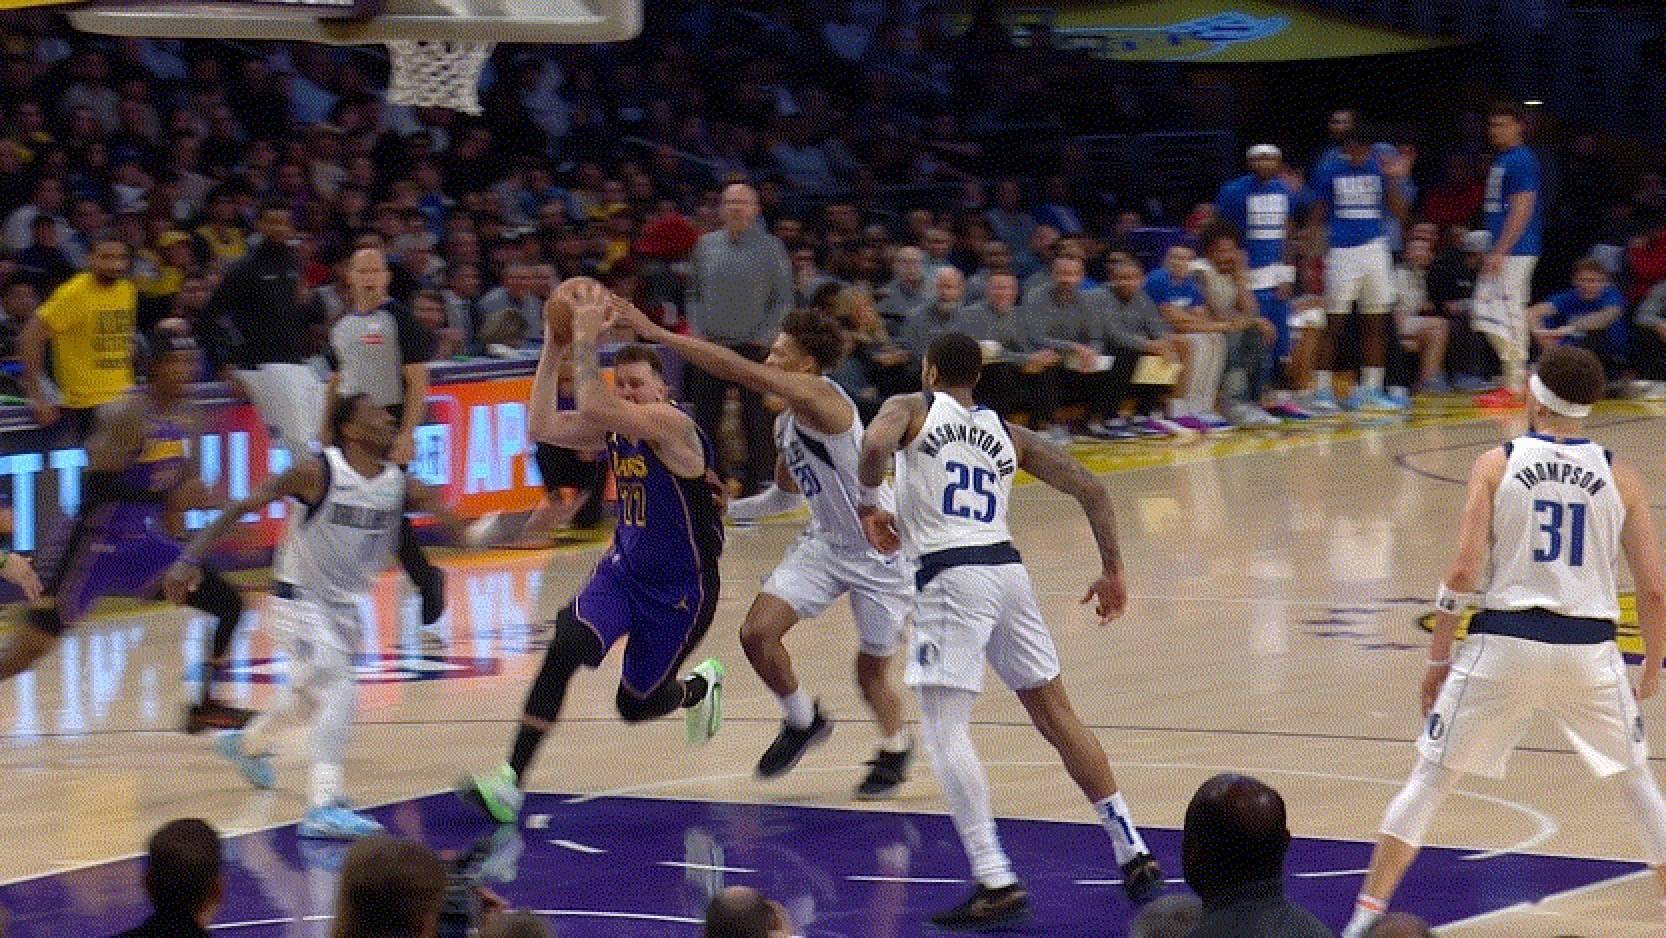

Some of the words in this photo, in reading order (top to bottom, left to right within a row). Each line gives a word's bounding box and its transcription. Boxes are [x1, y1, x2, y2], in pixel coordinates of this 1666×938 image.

[919, 423, 1003, 458] WASHINGTON
[943, 460, 996, 523] 25
[1514, 461, 1606, 496] THOMPSON
[1533, 499, 1586, 567] 31
